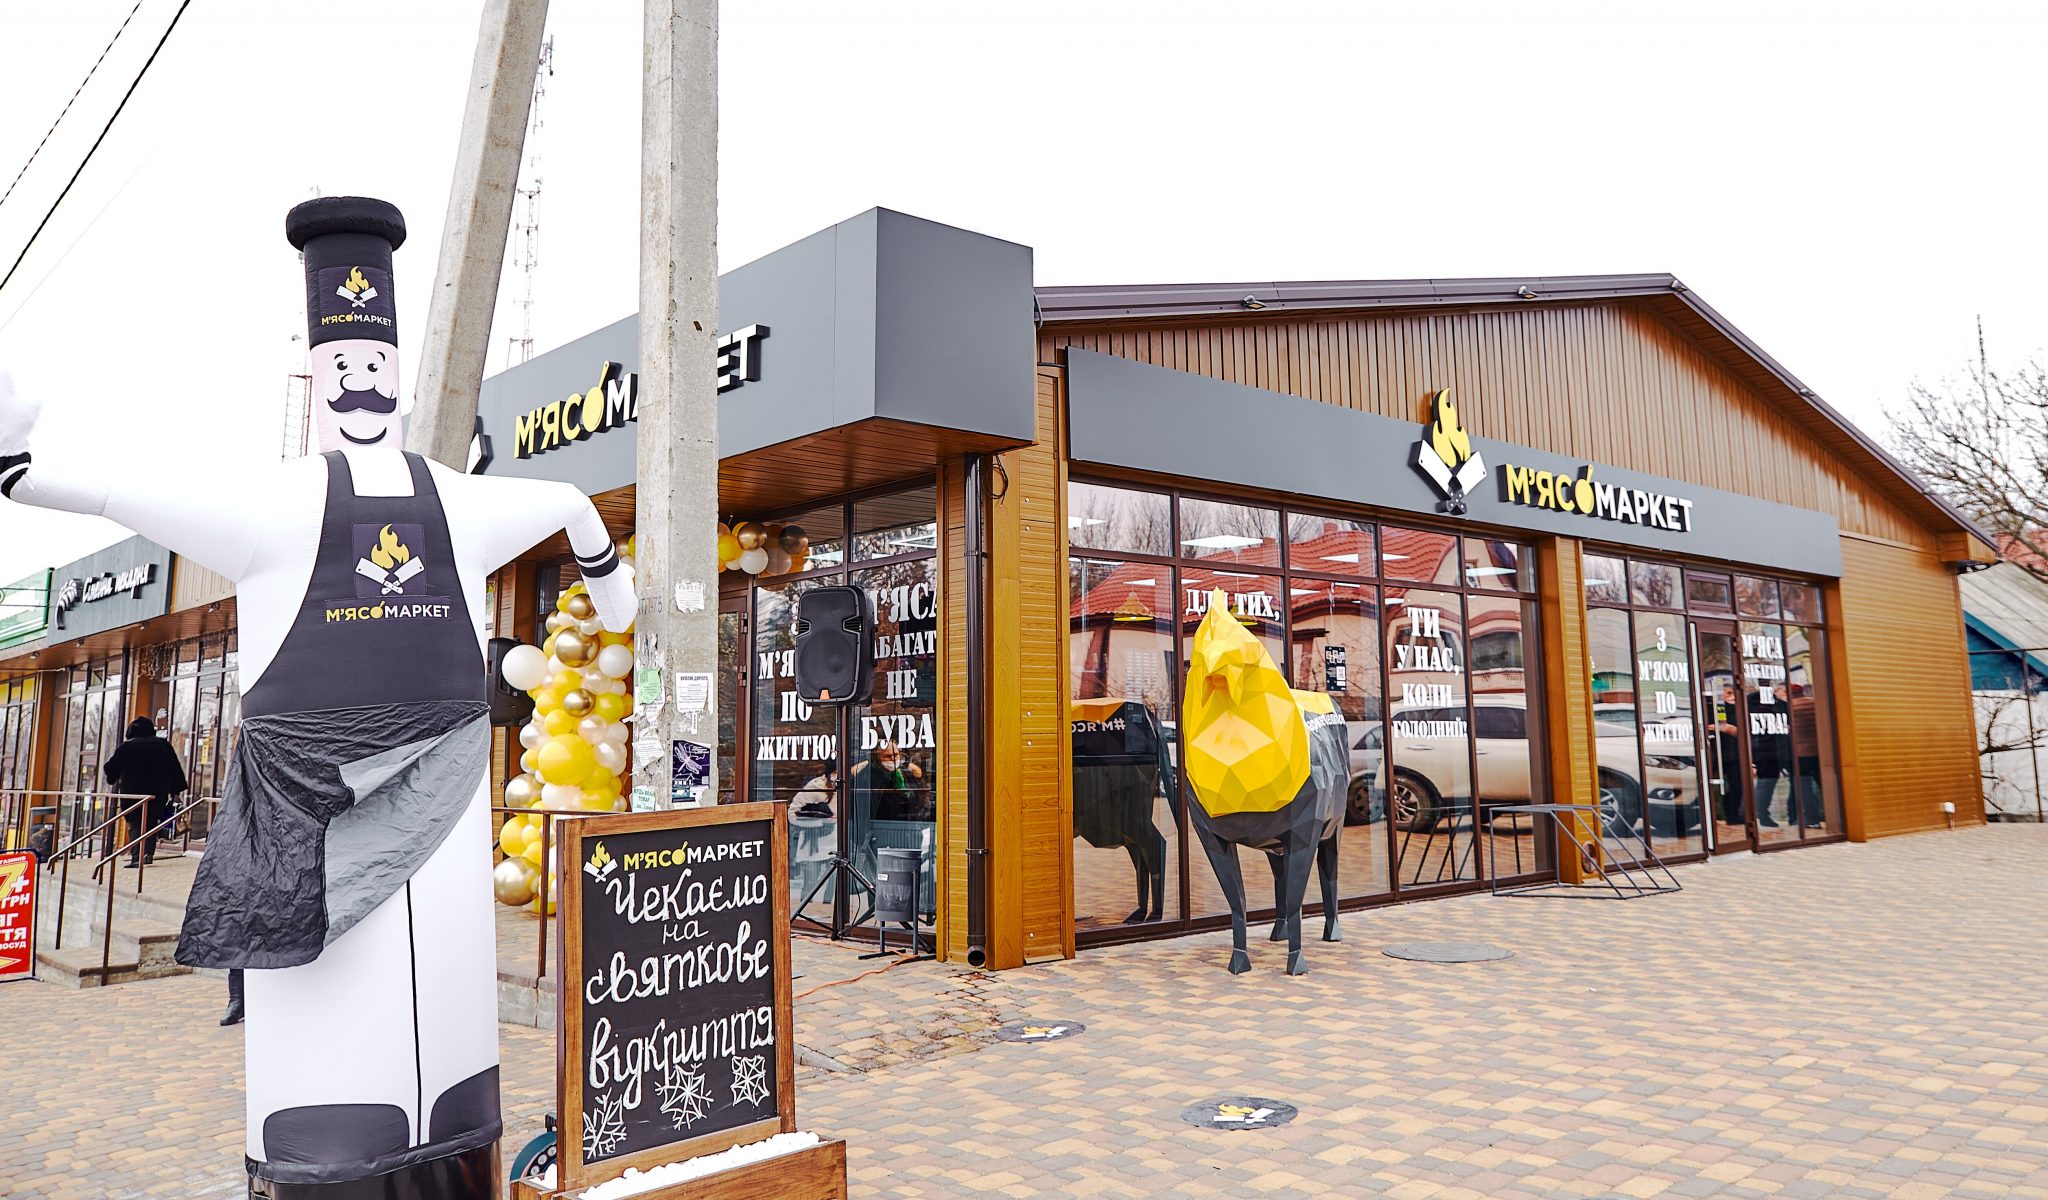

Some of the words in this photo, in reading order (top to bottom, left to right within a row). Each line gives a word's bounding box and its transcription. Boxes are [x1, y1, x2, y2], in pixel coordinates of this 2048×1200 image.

[321, 311, 392, 327] М'ЯСОМАРКЕТ
[514, 324, 757, 459] М'ЯСОМЕТ
[1505, 464, 1693, 532] М'ЯСОМАРКЕТ
[326, 601, 450, 622] М'ЯСОМАРКЕТ
[870, 582, 937, 626] 'ЯС
[1186, 589, 1228, 617] ДЛ
[1235, 593, 1280, 621] ТИХ,
[1407, 607, 1440, 638] ТИ
[873, 630, 937, 660] БАГАТ
[1741, 634, 1784, 660] М'ЯСА
[758, 650, 795, 680] М'Я
[1396, 644, 1409, 670] У
[1414, 645, 1460, 676] НАС,
[1638, 660, 1689, 682] М'ЯСОМ
[886, 669, 918, 699] НЕ
[1402, 683, 1453, 707] КОЛИ
[1759, 686, 1775, 705] НЕ
[1655, 691, 1676, 714] ПО
[1392, 717, 1467, 740] ГОЛОДНИЙ!
[1643, 723, 1694, 742] ЖИТТЮ!
[1750, 712, 1789, 735] БУВА!
[757, 735, 837, 761] ЖИТТЮ!
[623, 840, 764, 871] М'ЯСОМАРКЕТ
[1, 893, 31, 909] ГРН
[662, 919, 709, 945] на
